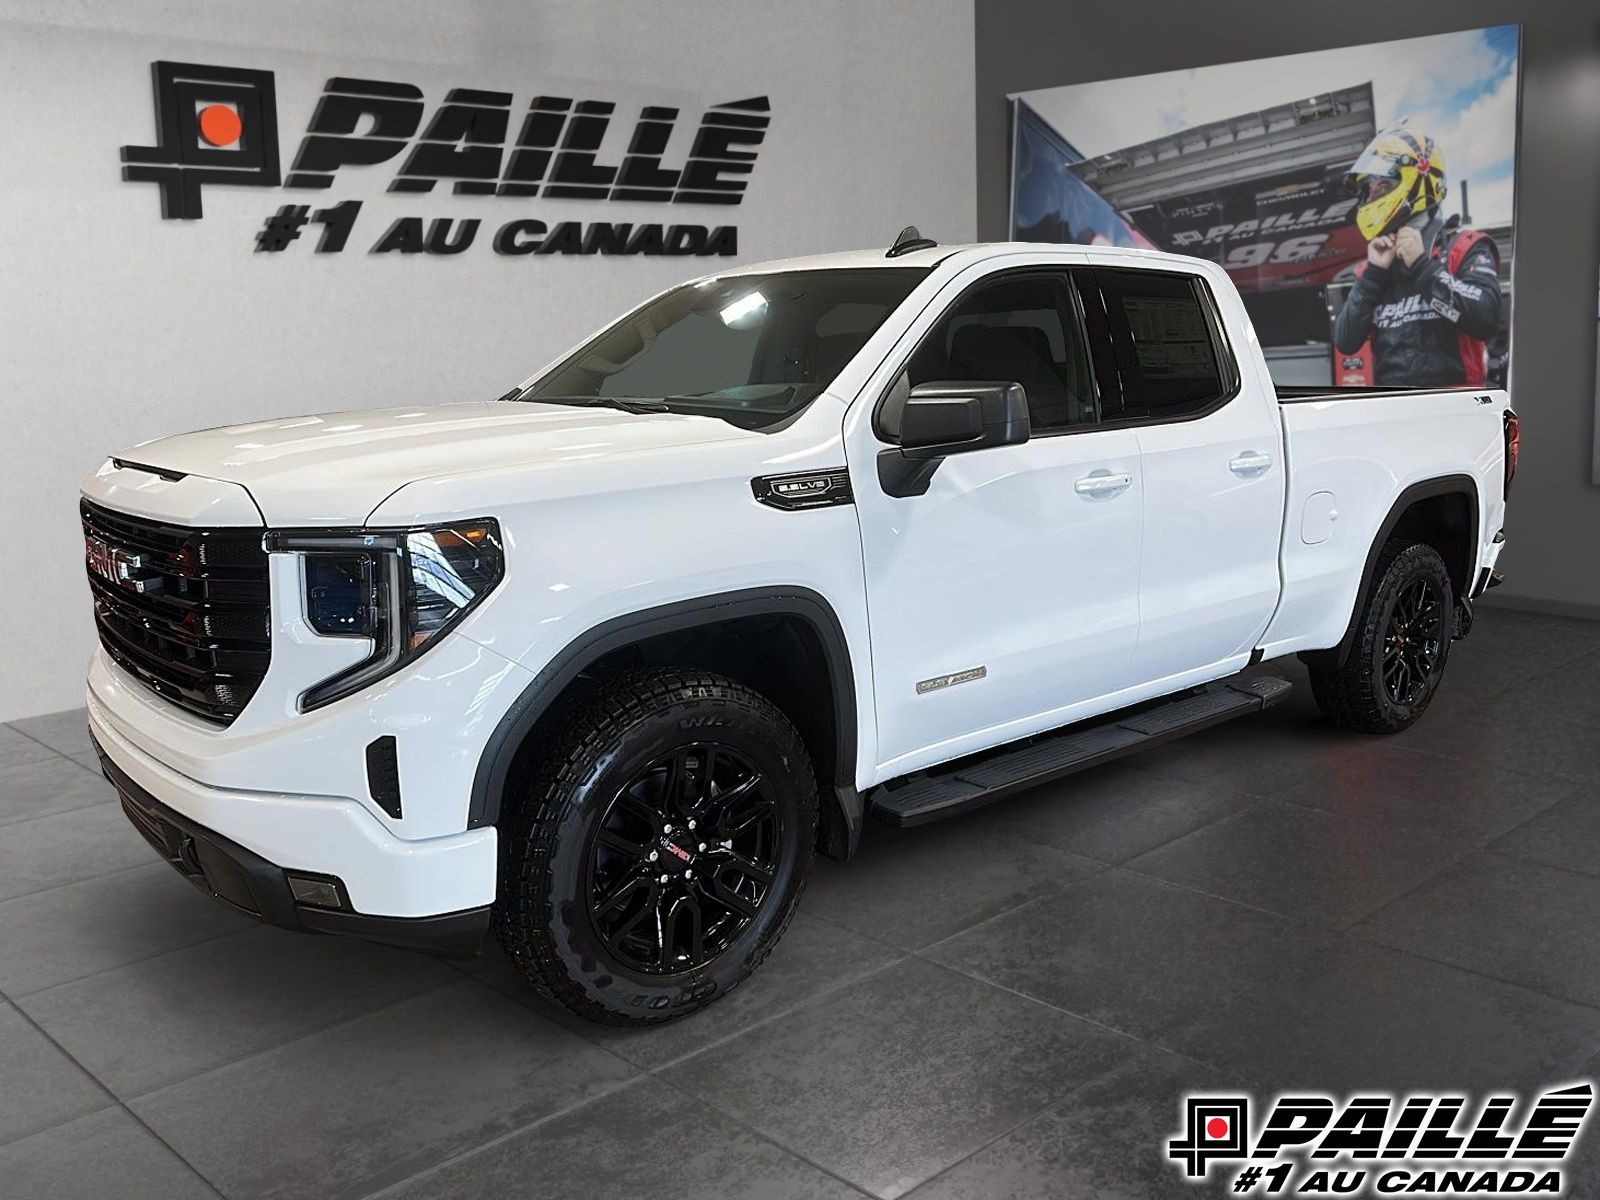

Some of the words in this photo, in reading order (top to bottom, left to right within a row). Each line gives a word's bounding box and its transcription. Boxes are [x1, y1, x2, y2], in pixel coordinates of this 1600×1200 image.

[282, 76, 771, 205] PAILLÉ
[253, 199, 364, 253] #1
[367, 216, 482, 254] AU
[492, 218, 738, 257] CANADA
[1224, 233, 1330, 270] 96
